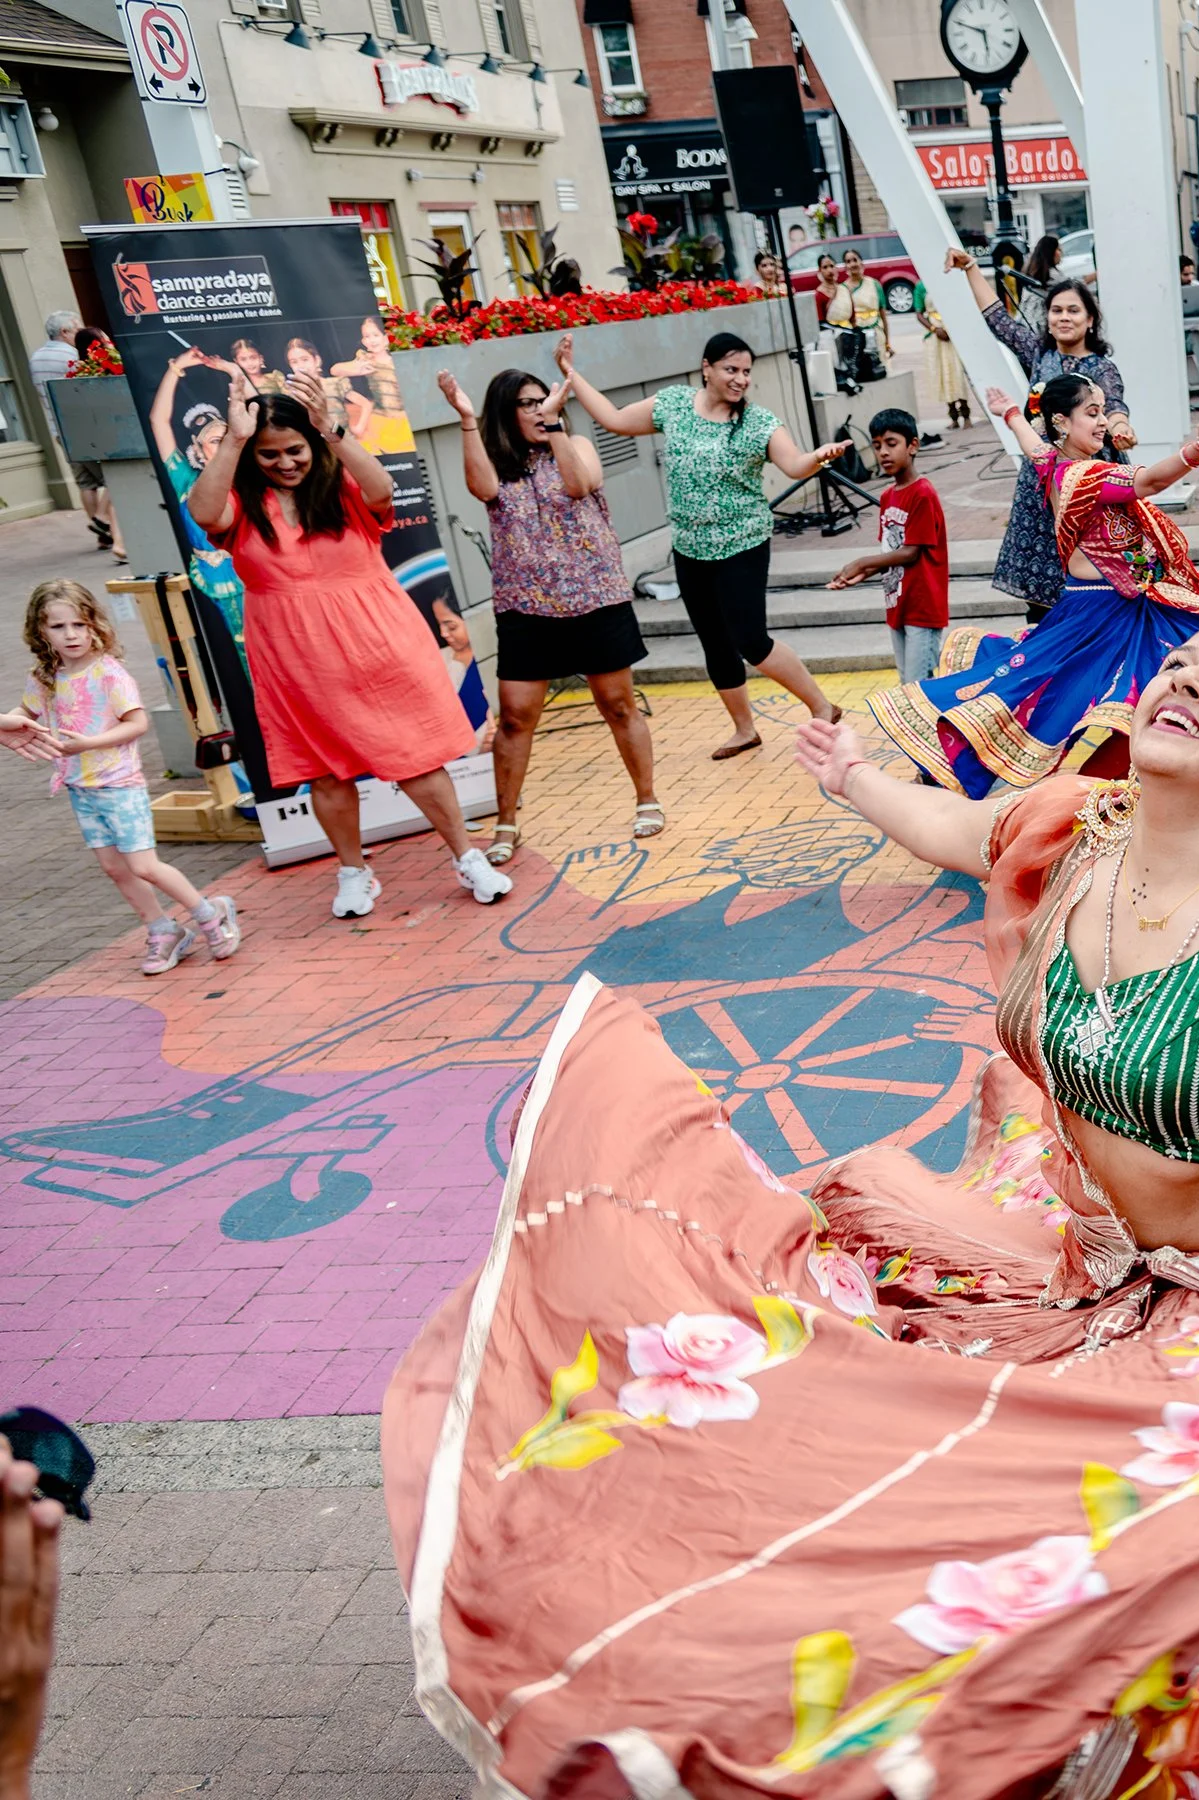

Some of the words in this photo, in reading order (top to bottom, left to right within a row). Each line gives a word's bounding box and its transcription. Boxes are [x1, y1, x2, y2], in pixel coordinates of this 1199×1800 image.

[928, 145, 996, 180] Salon
[614, 185, 637, 196] DAY
[638, 183, 662, 195] SPA
[671, 180, 711, 192] SALON
[140, 182, 194, 222] Busk
[151, 269, 272, 293] sampradaya
[156, 294, 205, 311] dance
[206, 288, 275, 307] academy
[162, 313, 207, 324] Nurturing
[213, 310, 243, 324] passion
[245, 308, 258, 317] for
[259, 307, 283, 317] dance
